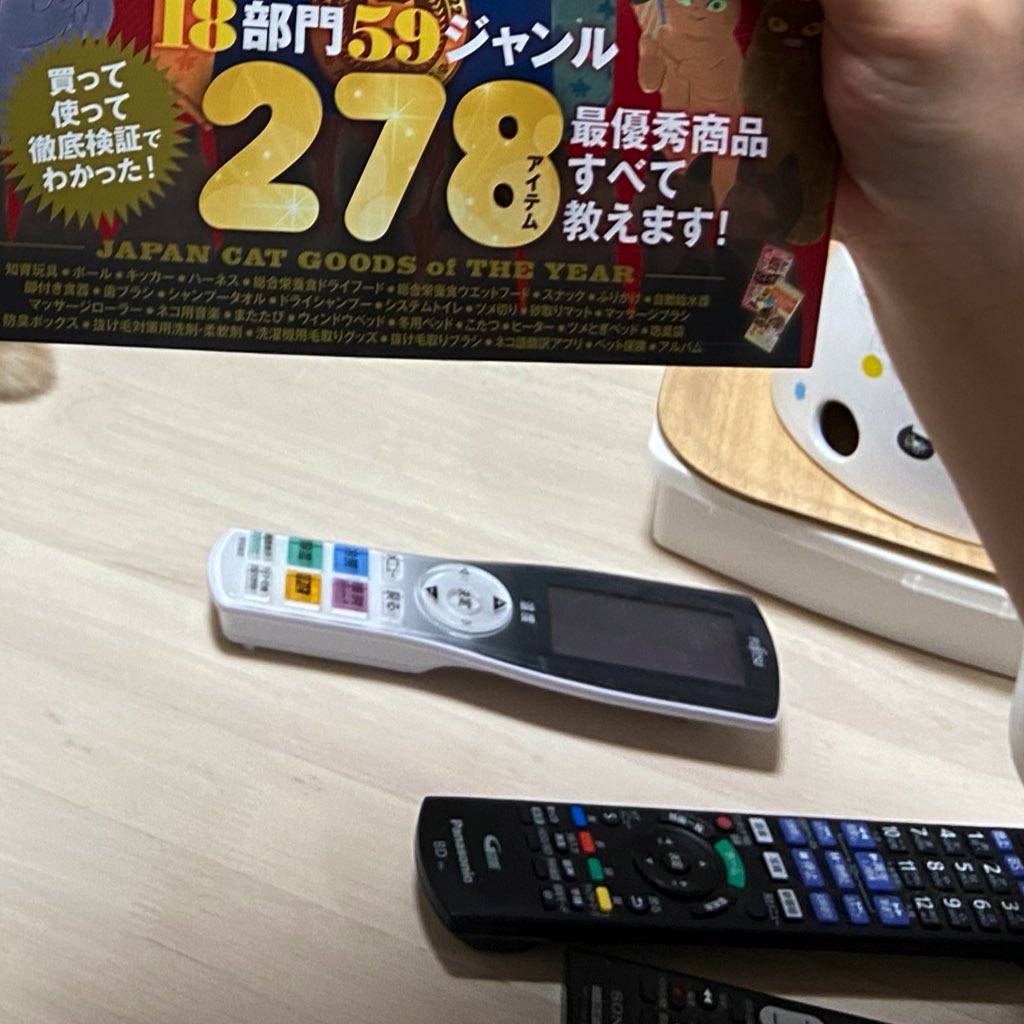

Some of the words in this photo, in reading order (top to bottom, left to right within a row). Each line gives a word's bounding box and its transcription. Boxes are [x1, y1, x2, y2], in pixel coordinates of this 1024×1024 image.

[47, 60, 128, 97] 買って
[50, 92, 131, 129] 使って
[569, 105, 769, 159] 最優秀商品
[27, 124, 162, 165] 徹底検証で
[198, 59, 566, 250] 278
[521, 155, 545, 231] アイテム
[567, 152, 688, 200] すべて
[96, 239, 212, 265] JAPAN
[222, 246, 288, 268] CAT
[297, 250, 417, 275] GOODS
[426, 257, 457, 276] of
[466, 258, 535, 279] THE
[544, 261, 636, 284] YEAR
[449, 817, 474, 885] Panasonic
